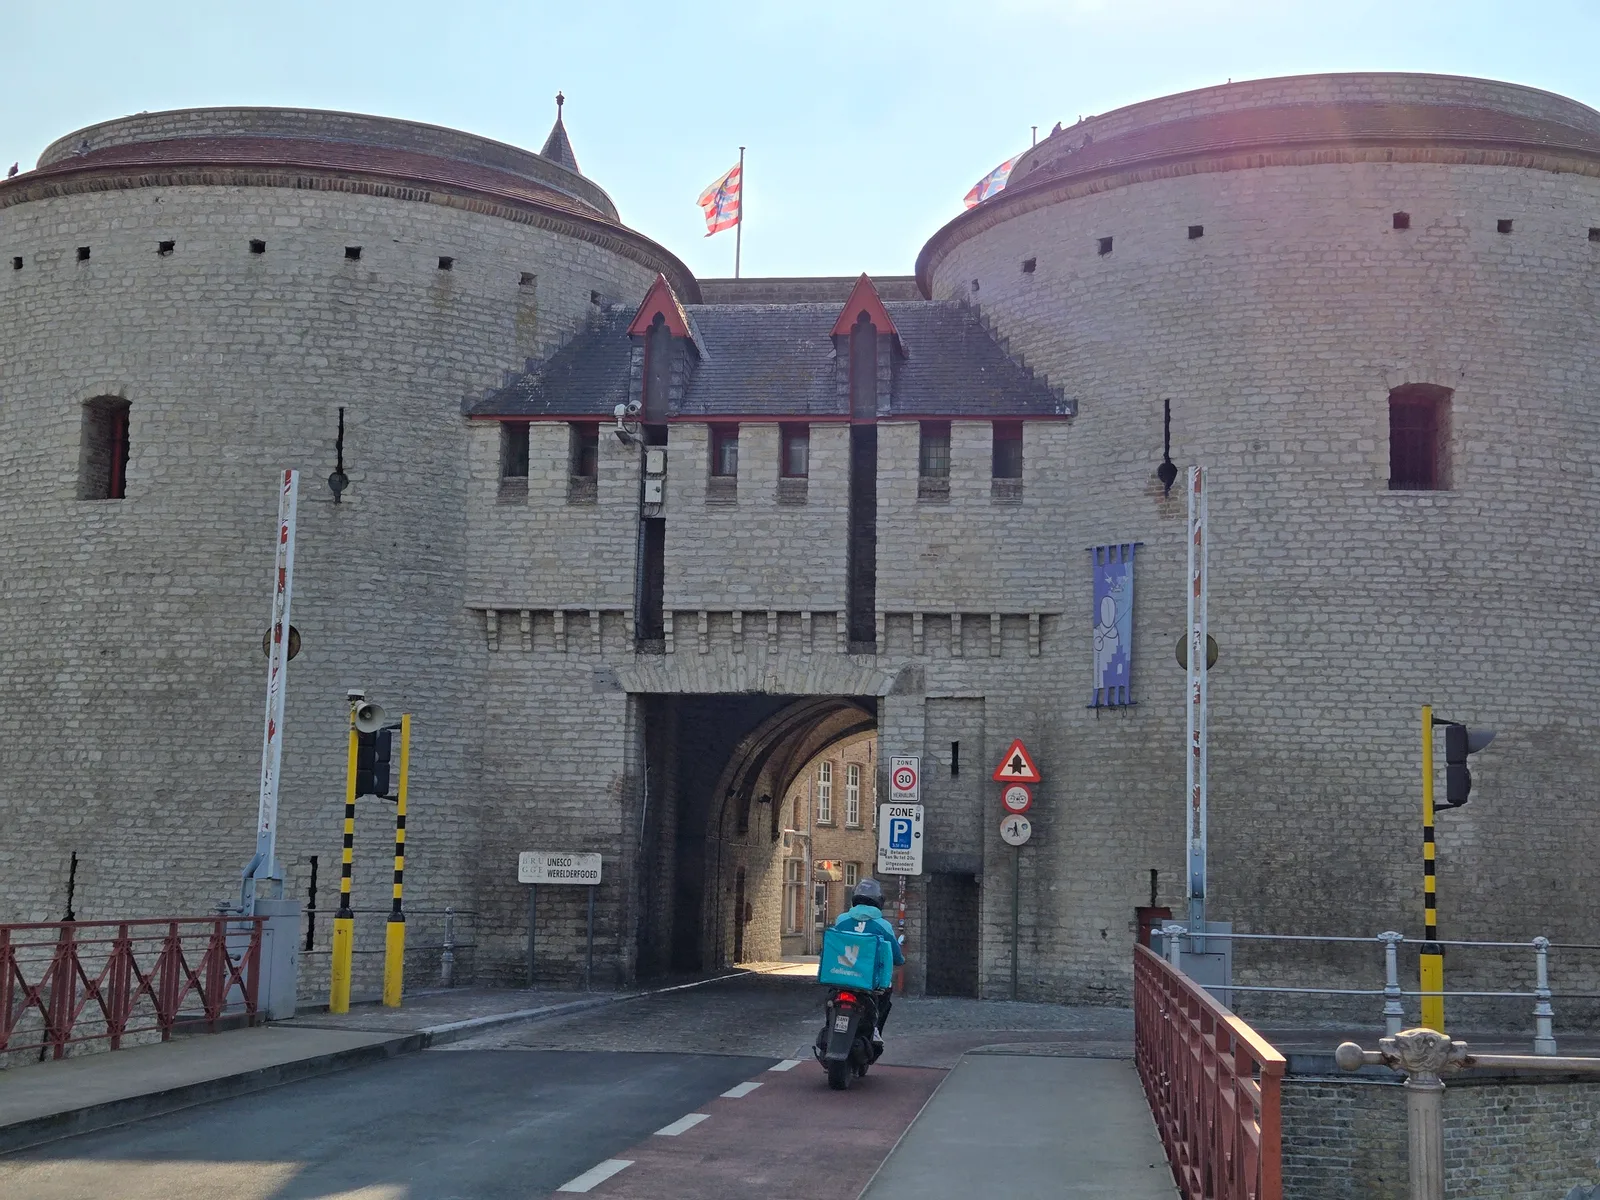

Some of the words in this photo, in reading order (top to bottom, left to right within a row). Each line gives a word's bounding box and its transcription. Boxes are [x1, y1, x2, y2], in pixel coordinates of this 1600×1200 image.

[898, 774, 911, 784] 30
[889, 807, 914, 817] ZONE
[893, 820, 909, 843] P
[547, 858, 572, 867] UNESCO
[547, 869, 598, 879] WERELDERFGOED
